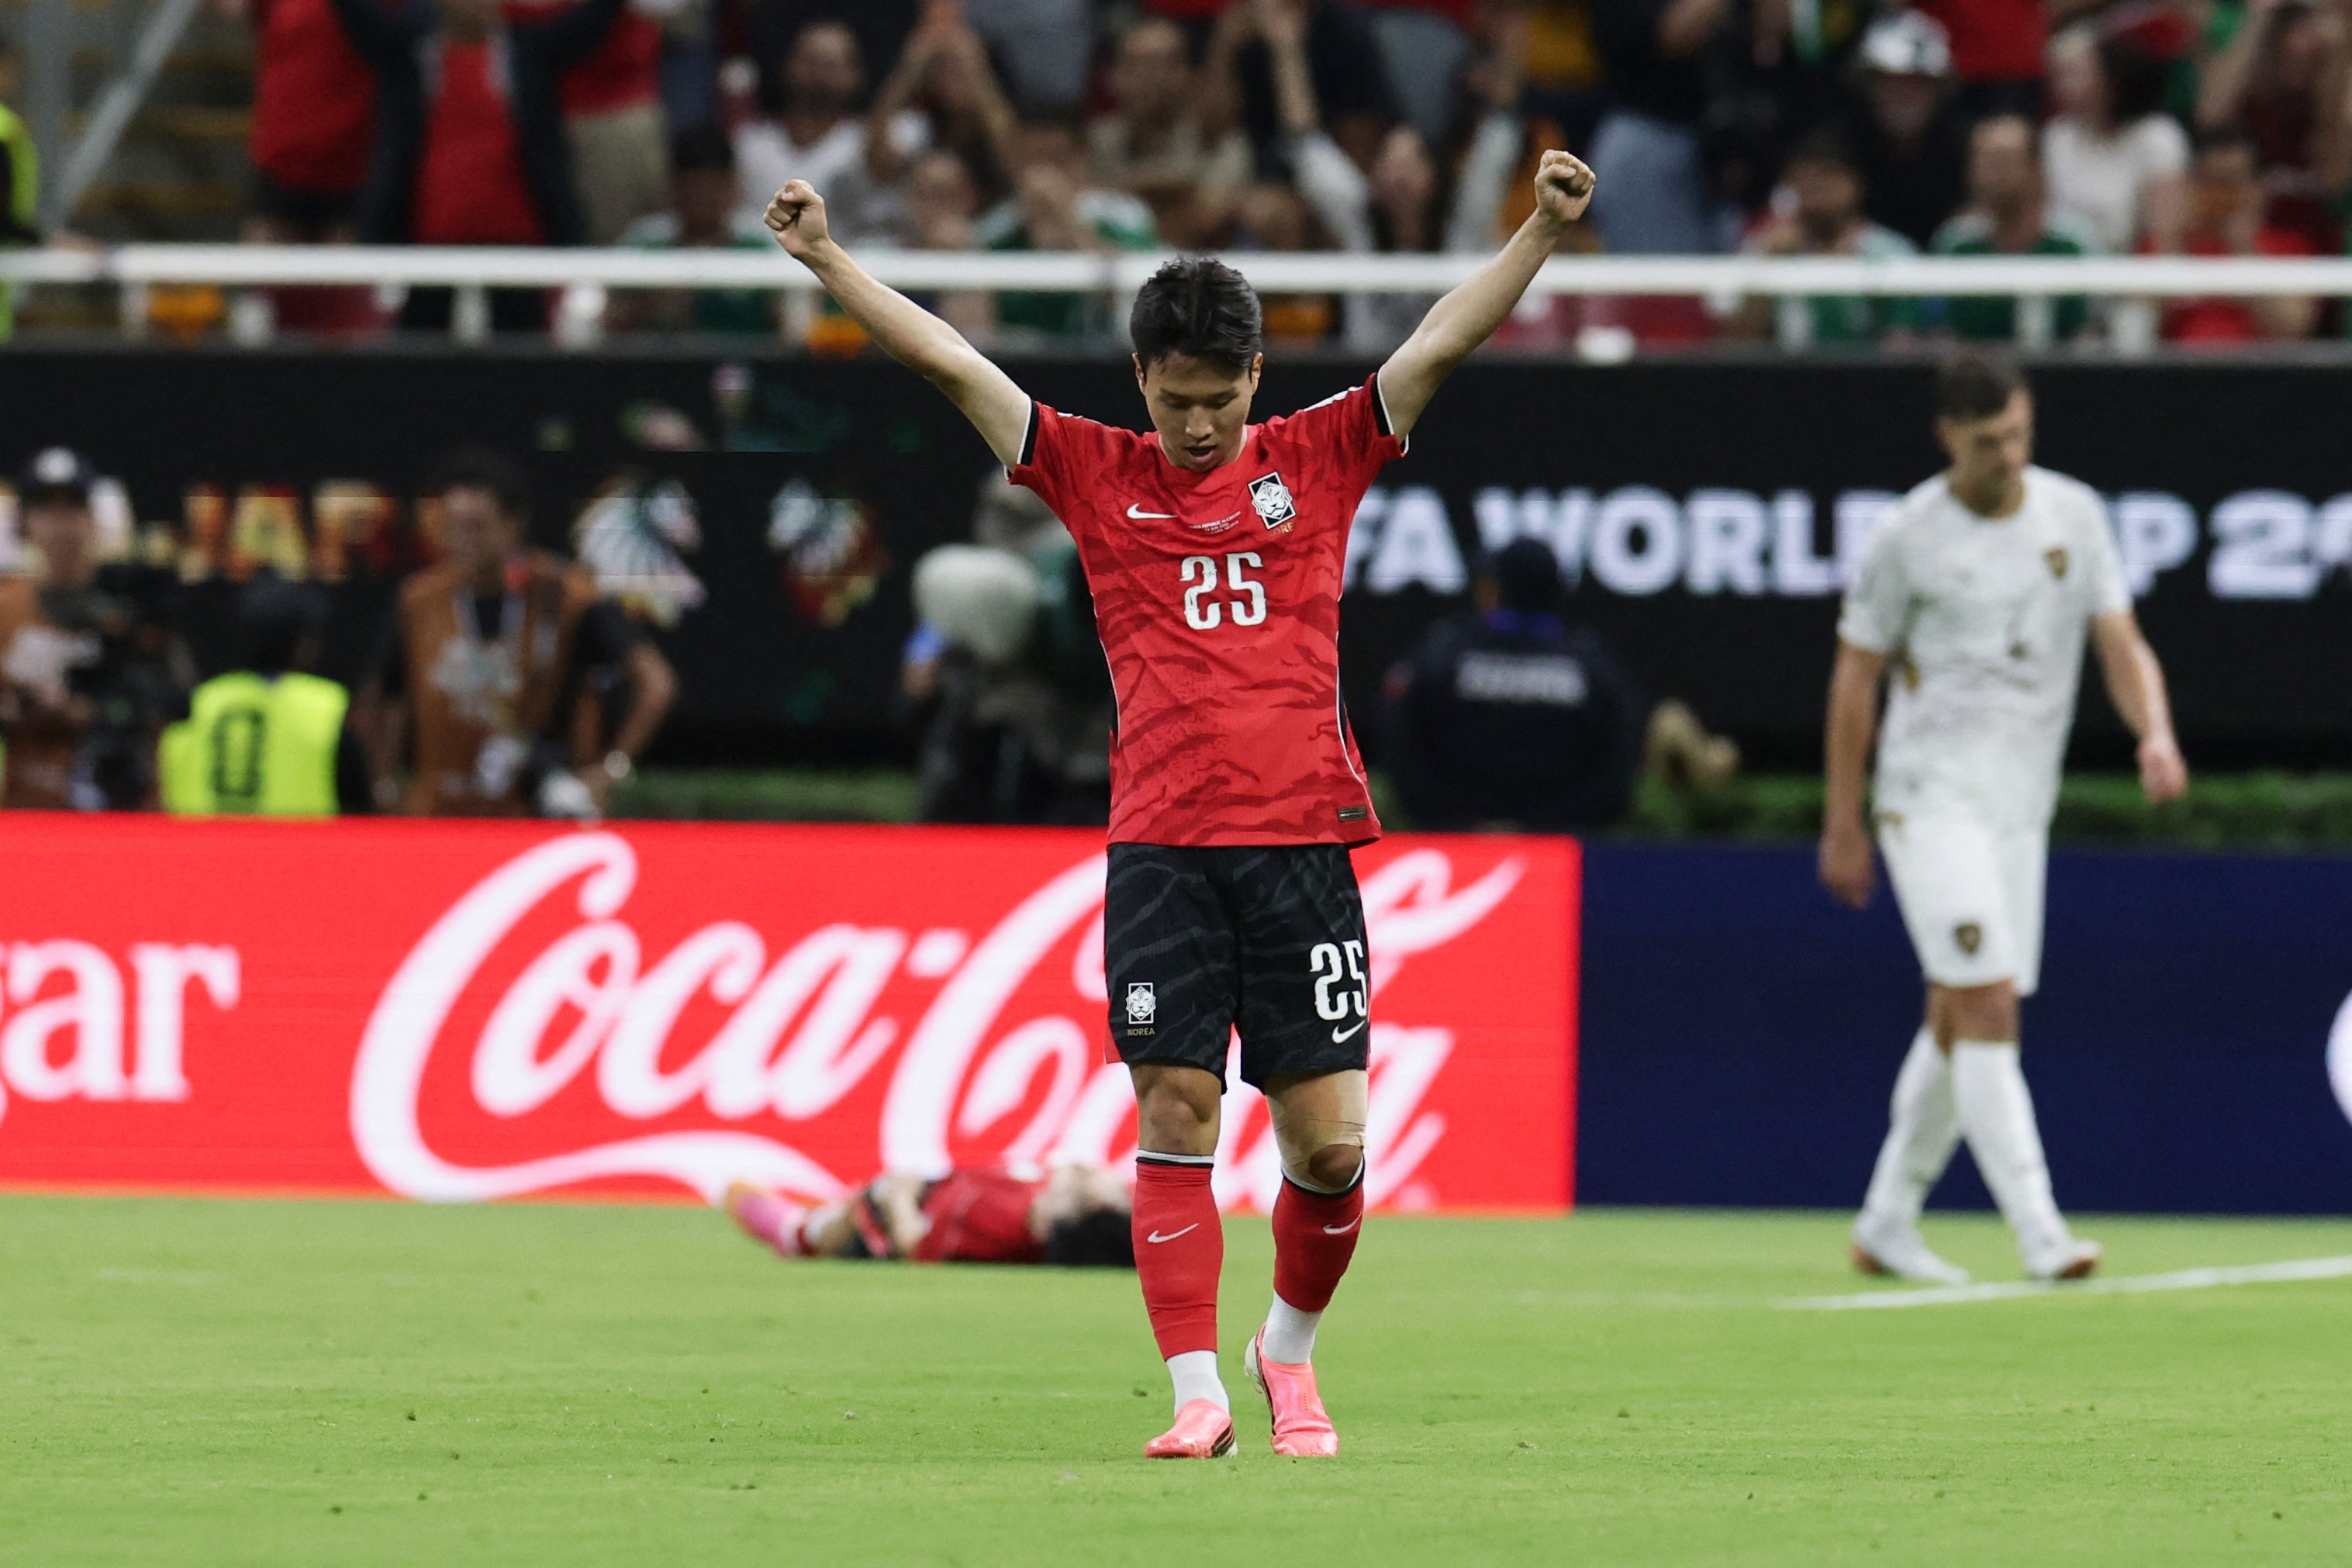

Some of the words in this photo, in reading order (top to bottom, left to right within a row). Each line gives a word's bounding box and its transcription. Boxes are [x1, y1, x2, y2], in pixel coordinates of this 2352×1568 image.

[1179, 551, 1267, 630] 25
[1309, 939, 1367, 1021] 25
[0, 938, 242, 1109] ar
[1127, 1027, 1155, 1036] KOREA
